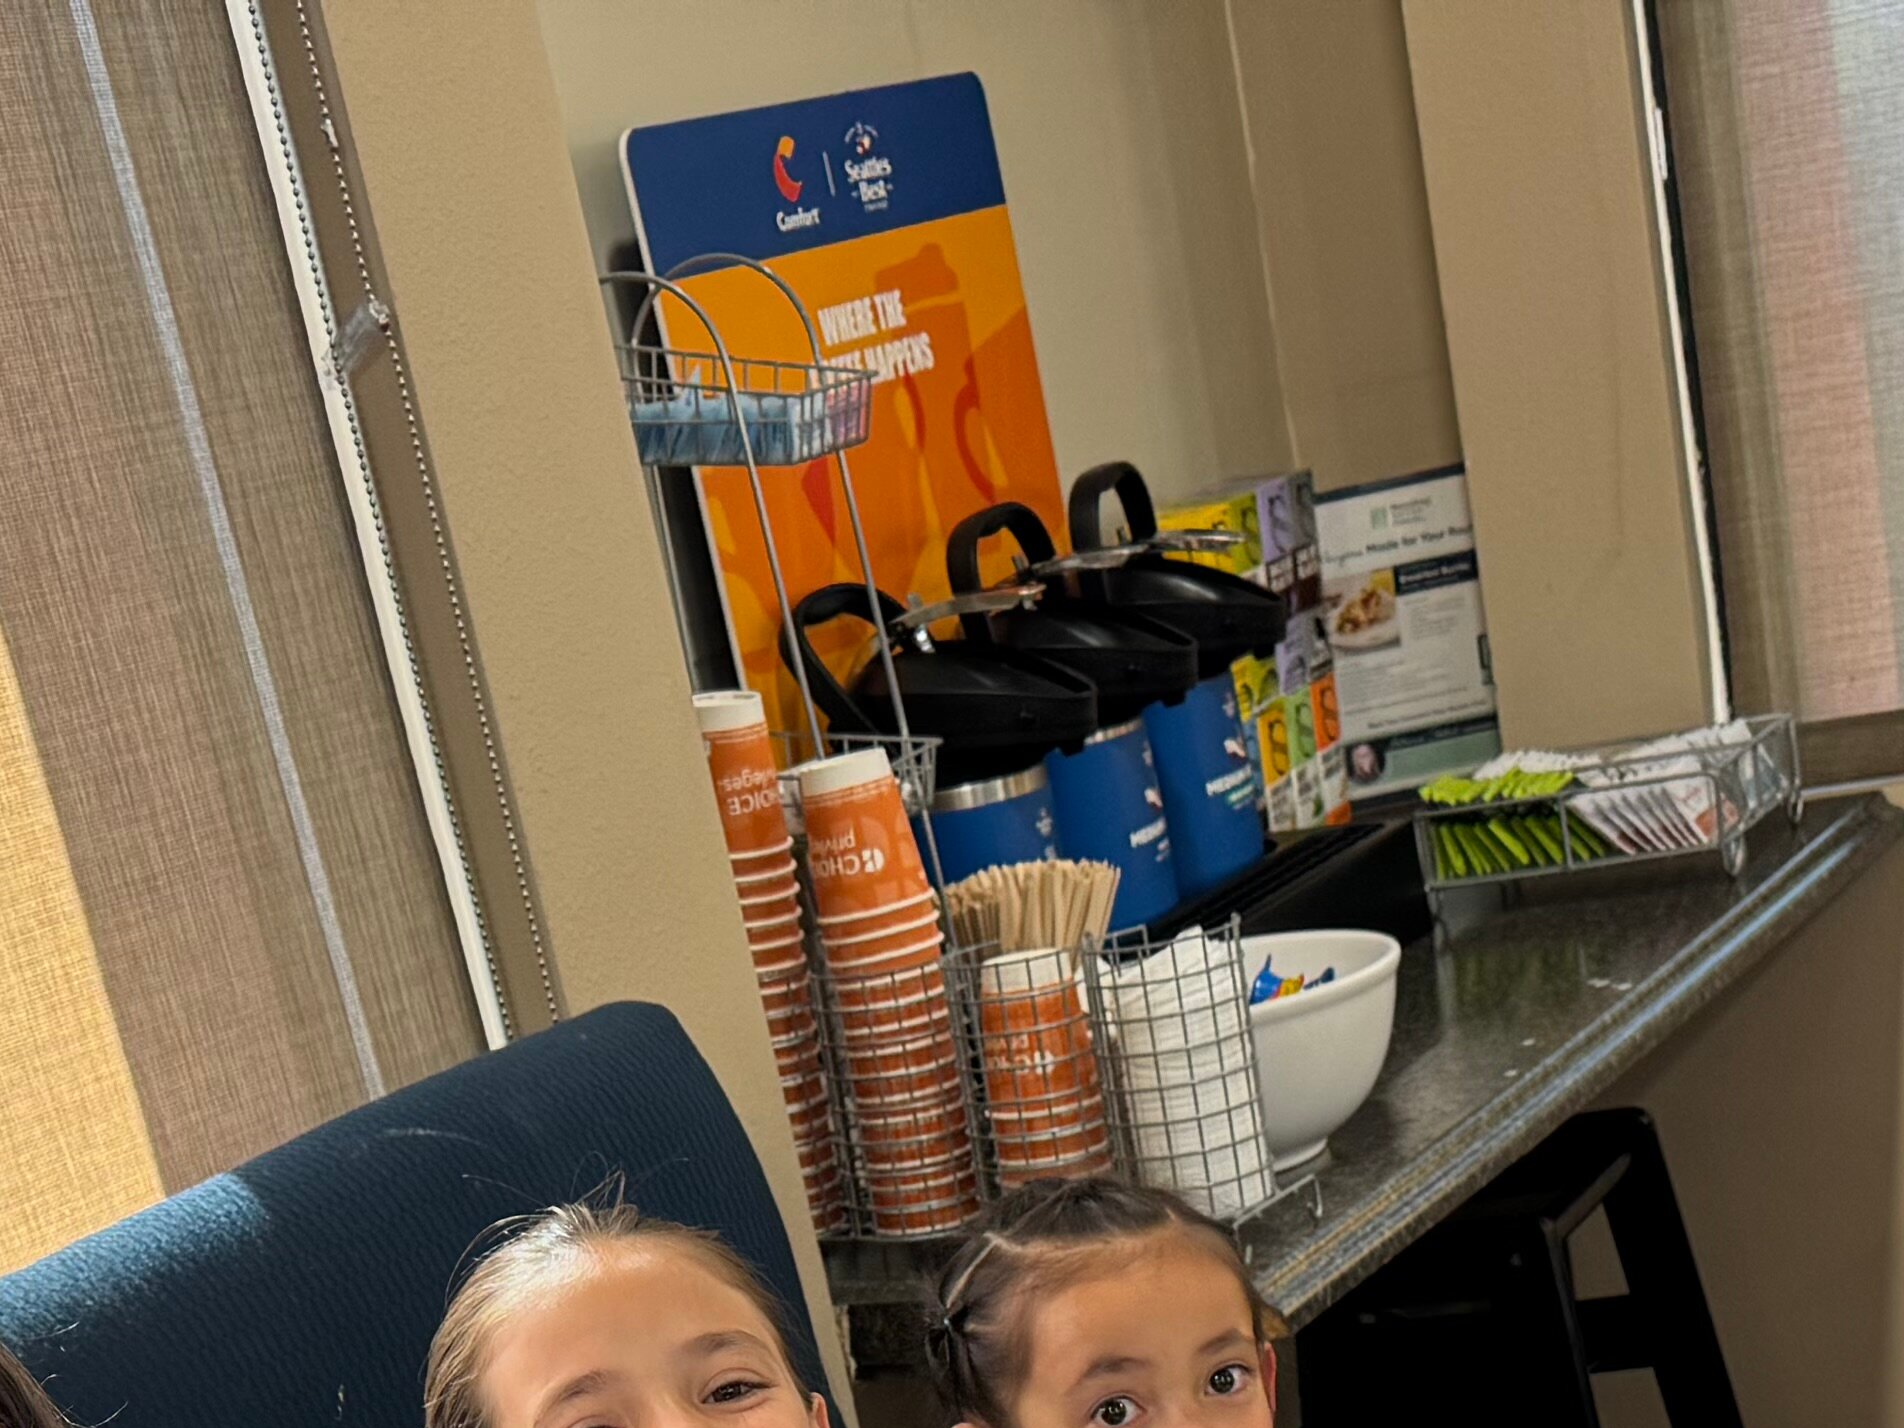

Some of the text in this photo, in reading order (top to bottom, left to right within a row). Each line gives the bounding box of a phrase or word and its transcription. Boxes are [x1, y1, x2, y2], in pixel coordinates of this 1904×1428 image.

[858, 180, 889, 203] Best
[776, 206, 820, 232] Comfort
[818, 288, 907, 346] WHERE THE
[865, 332, 934, 384] HAPPENS
